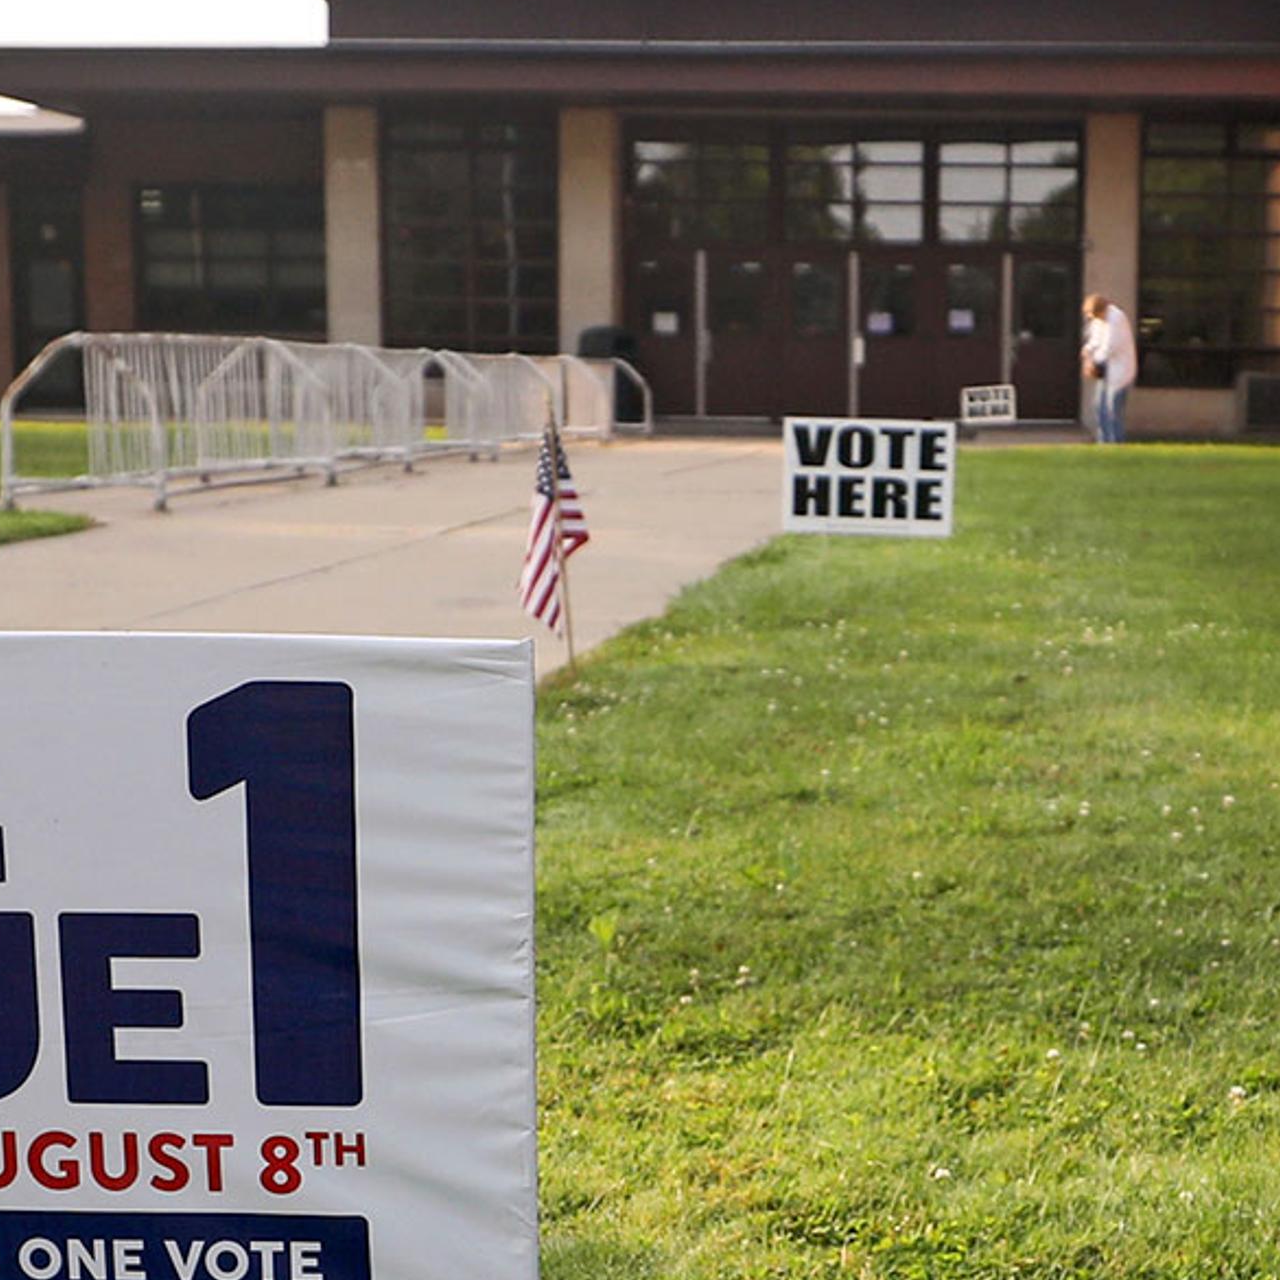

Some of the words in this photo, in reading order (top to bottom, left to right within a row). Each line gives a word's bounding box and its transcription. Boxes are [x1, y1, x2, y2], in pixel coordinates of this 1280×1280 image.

[793, 424, 947, 470] VOTE
[793, 474, 942, 521] HERE
[186, 680, 364, 1108] 1
[259, 1131, 366, 1195] 8TH
